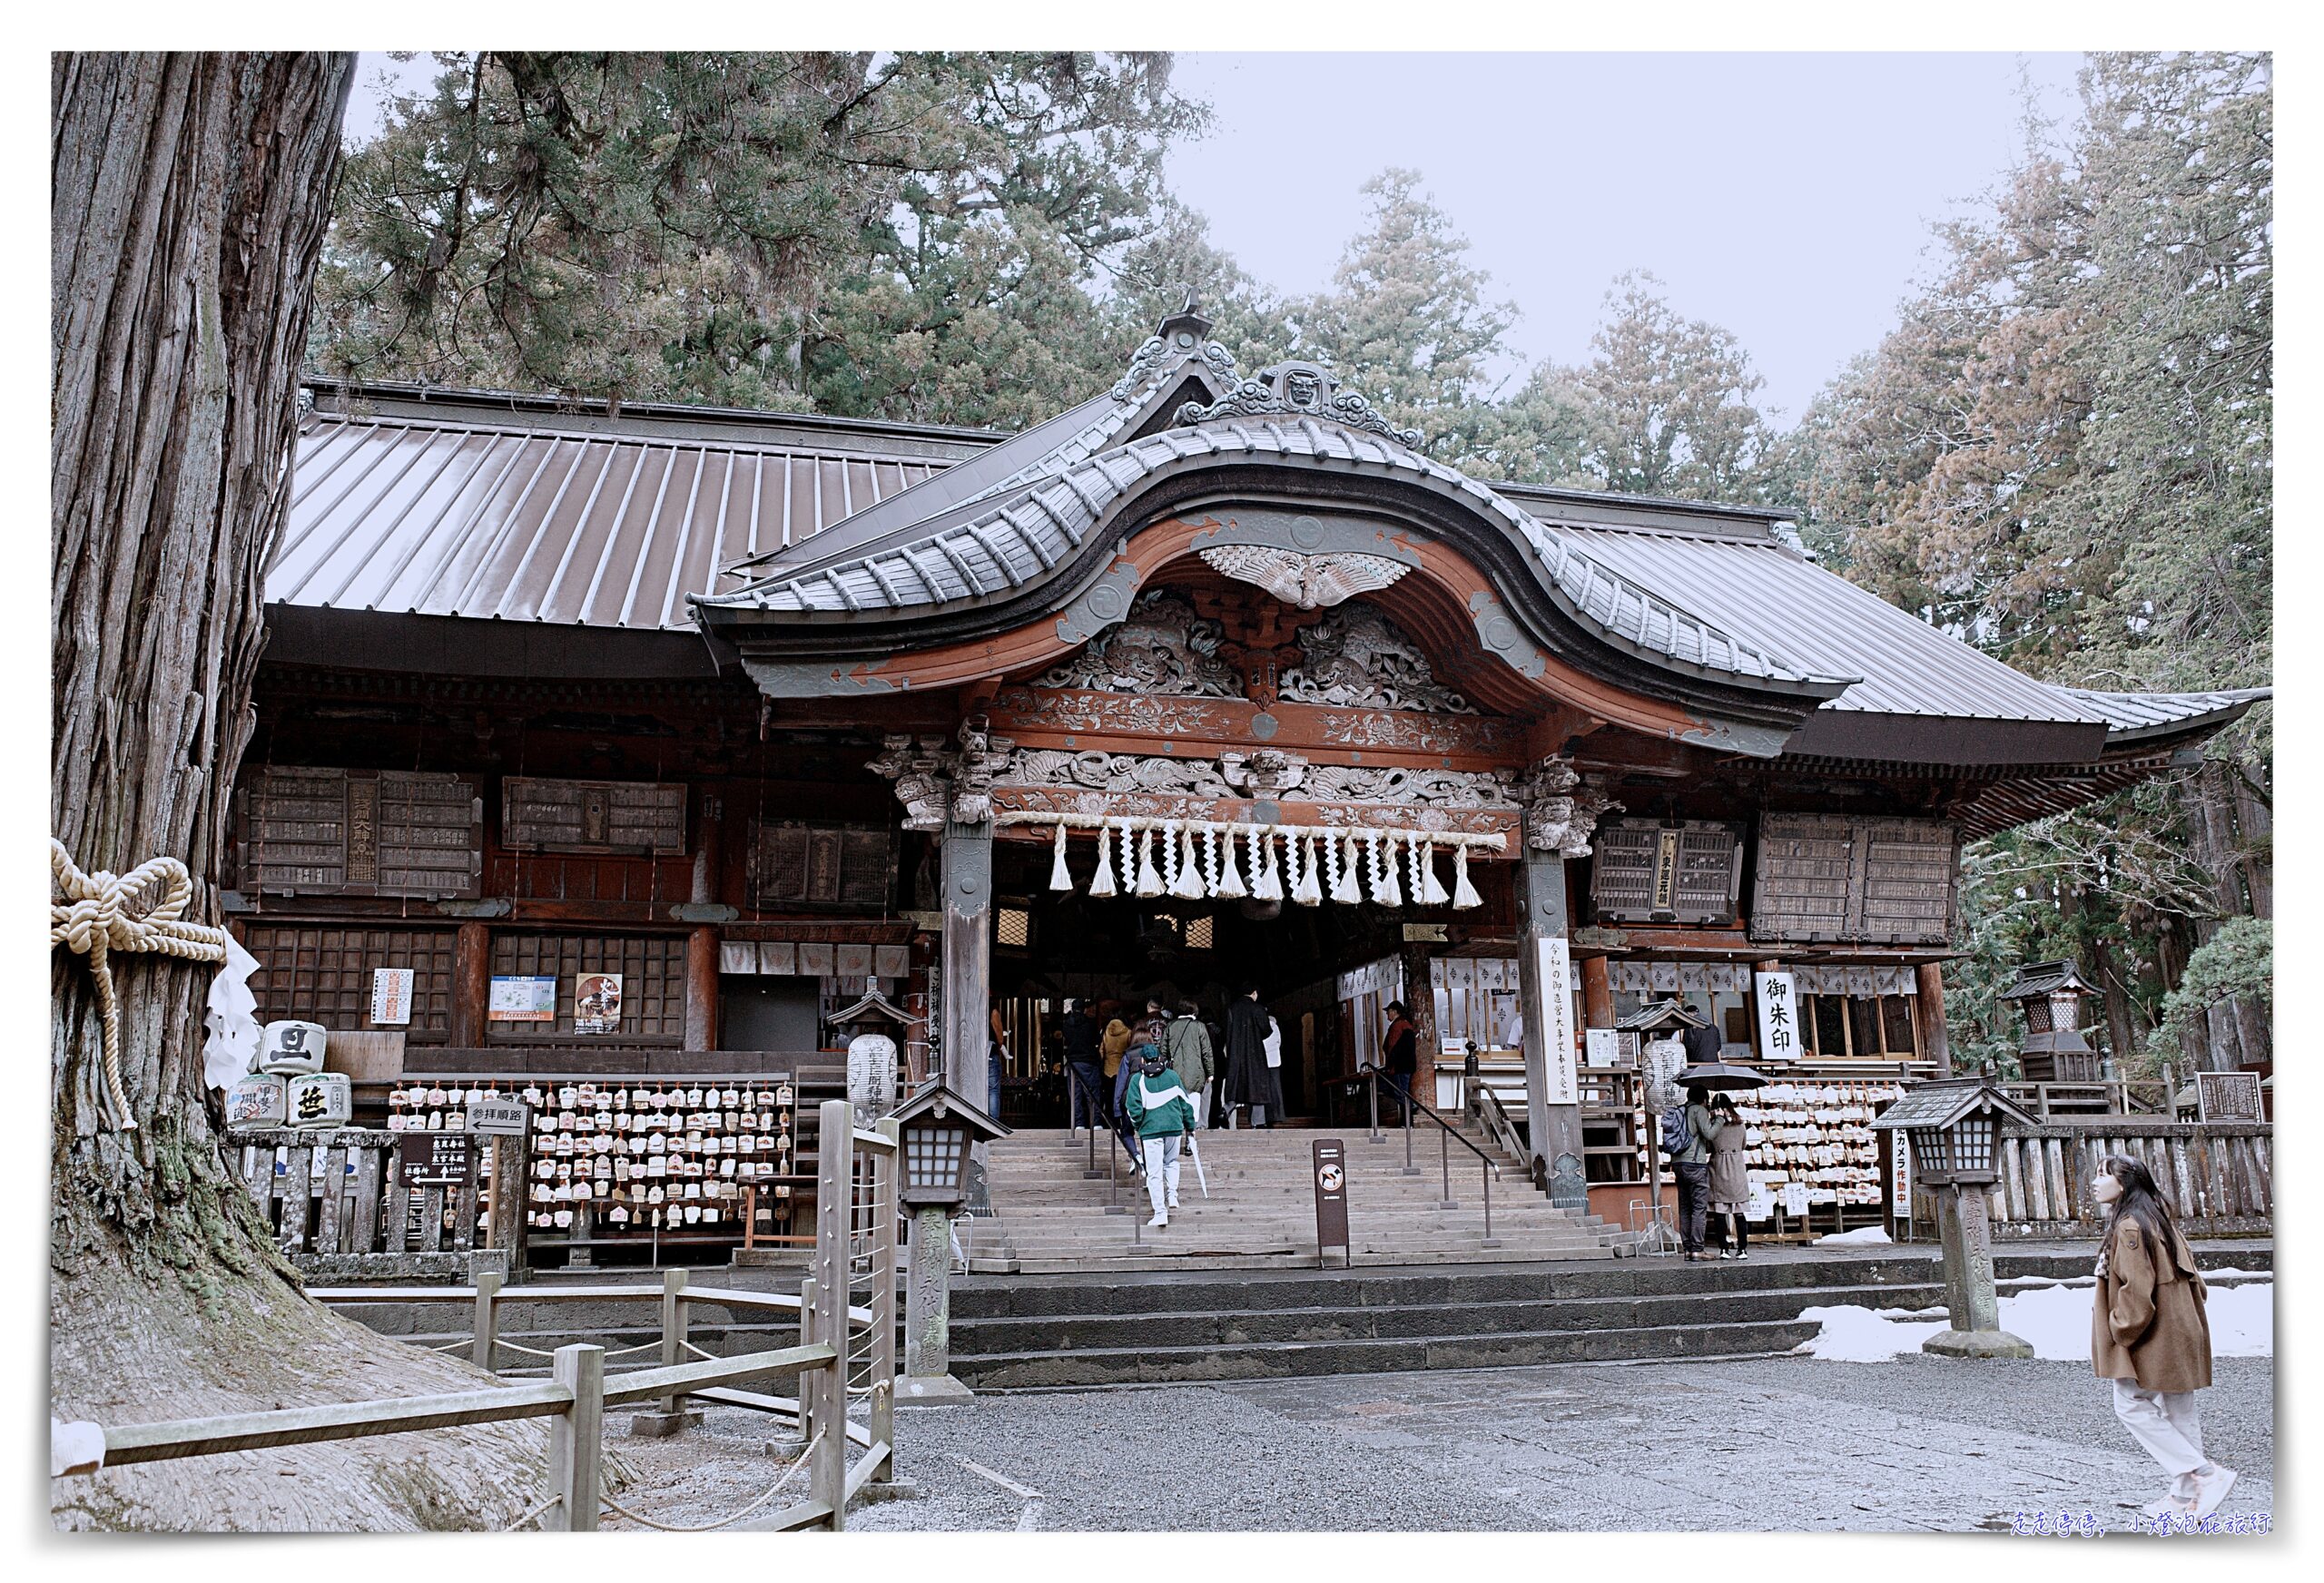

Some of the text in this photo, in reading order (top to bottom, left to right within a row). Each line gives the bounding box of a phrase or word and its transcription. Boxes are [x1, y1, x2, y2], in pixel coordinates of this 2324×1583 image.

[1766, 978, 1790, 1053] 御朱印
[472, 1108, 522, 1121] 参拝順路
